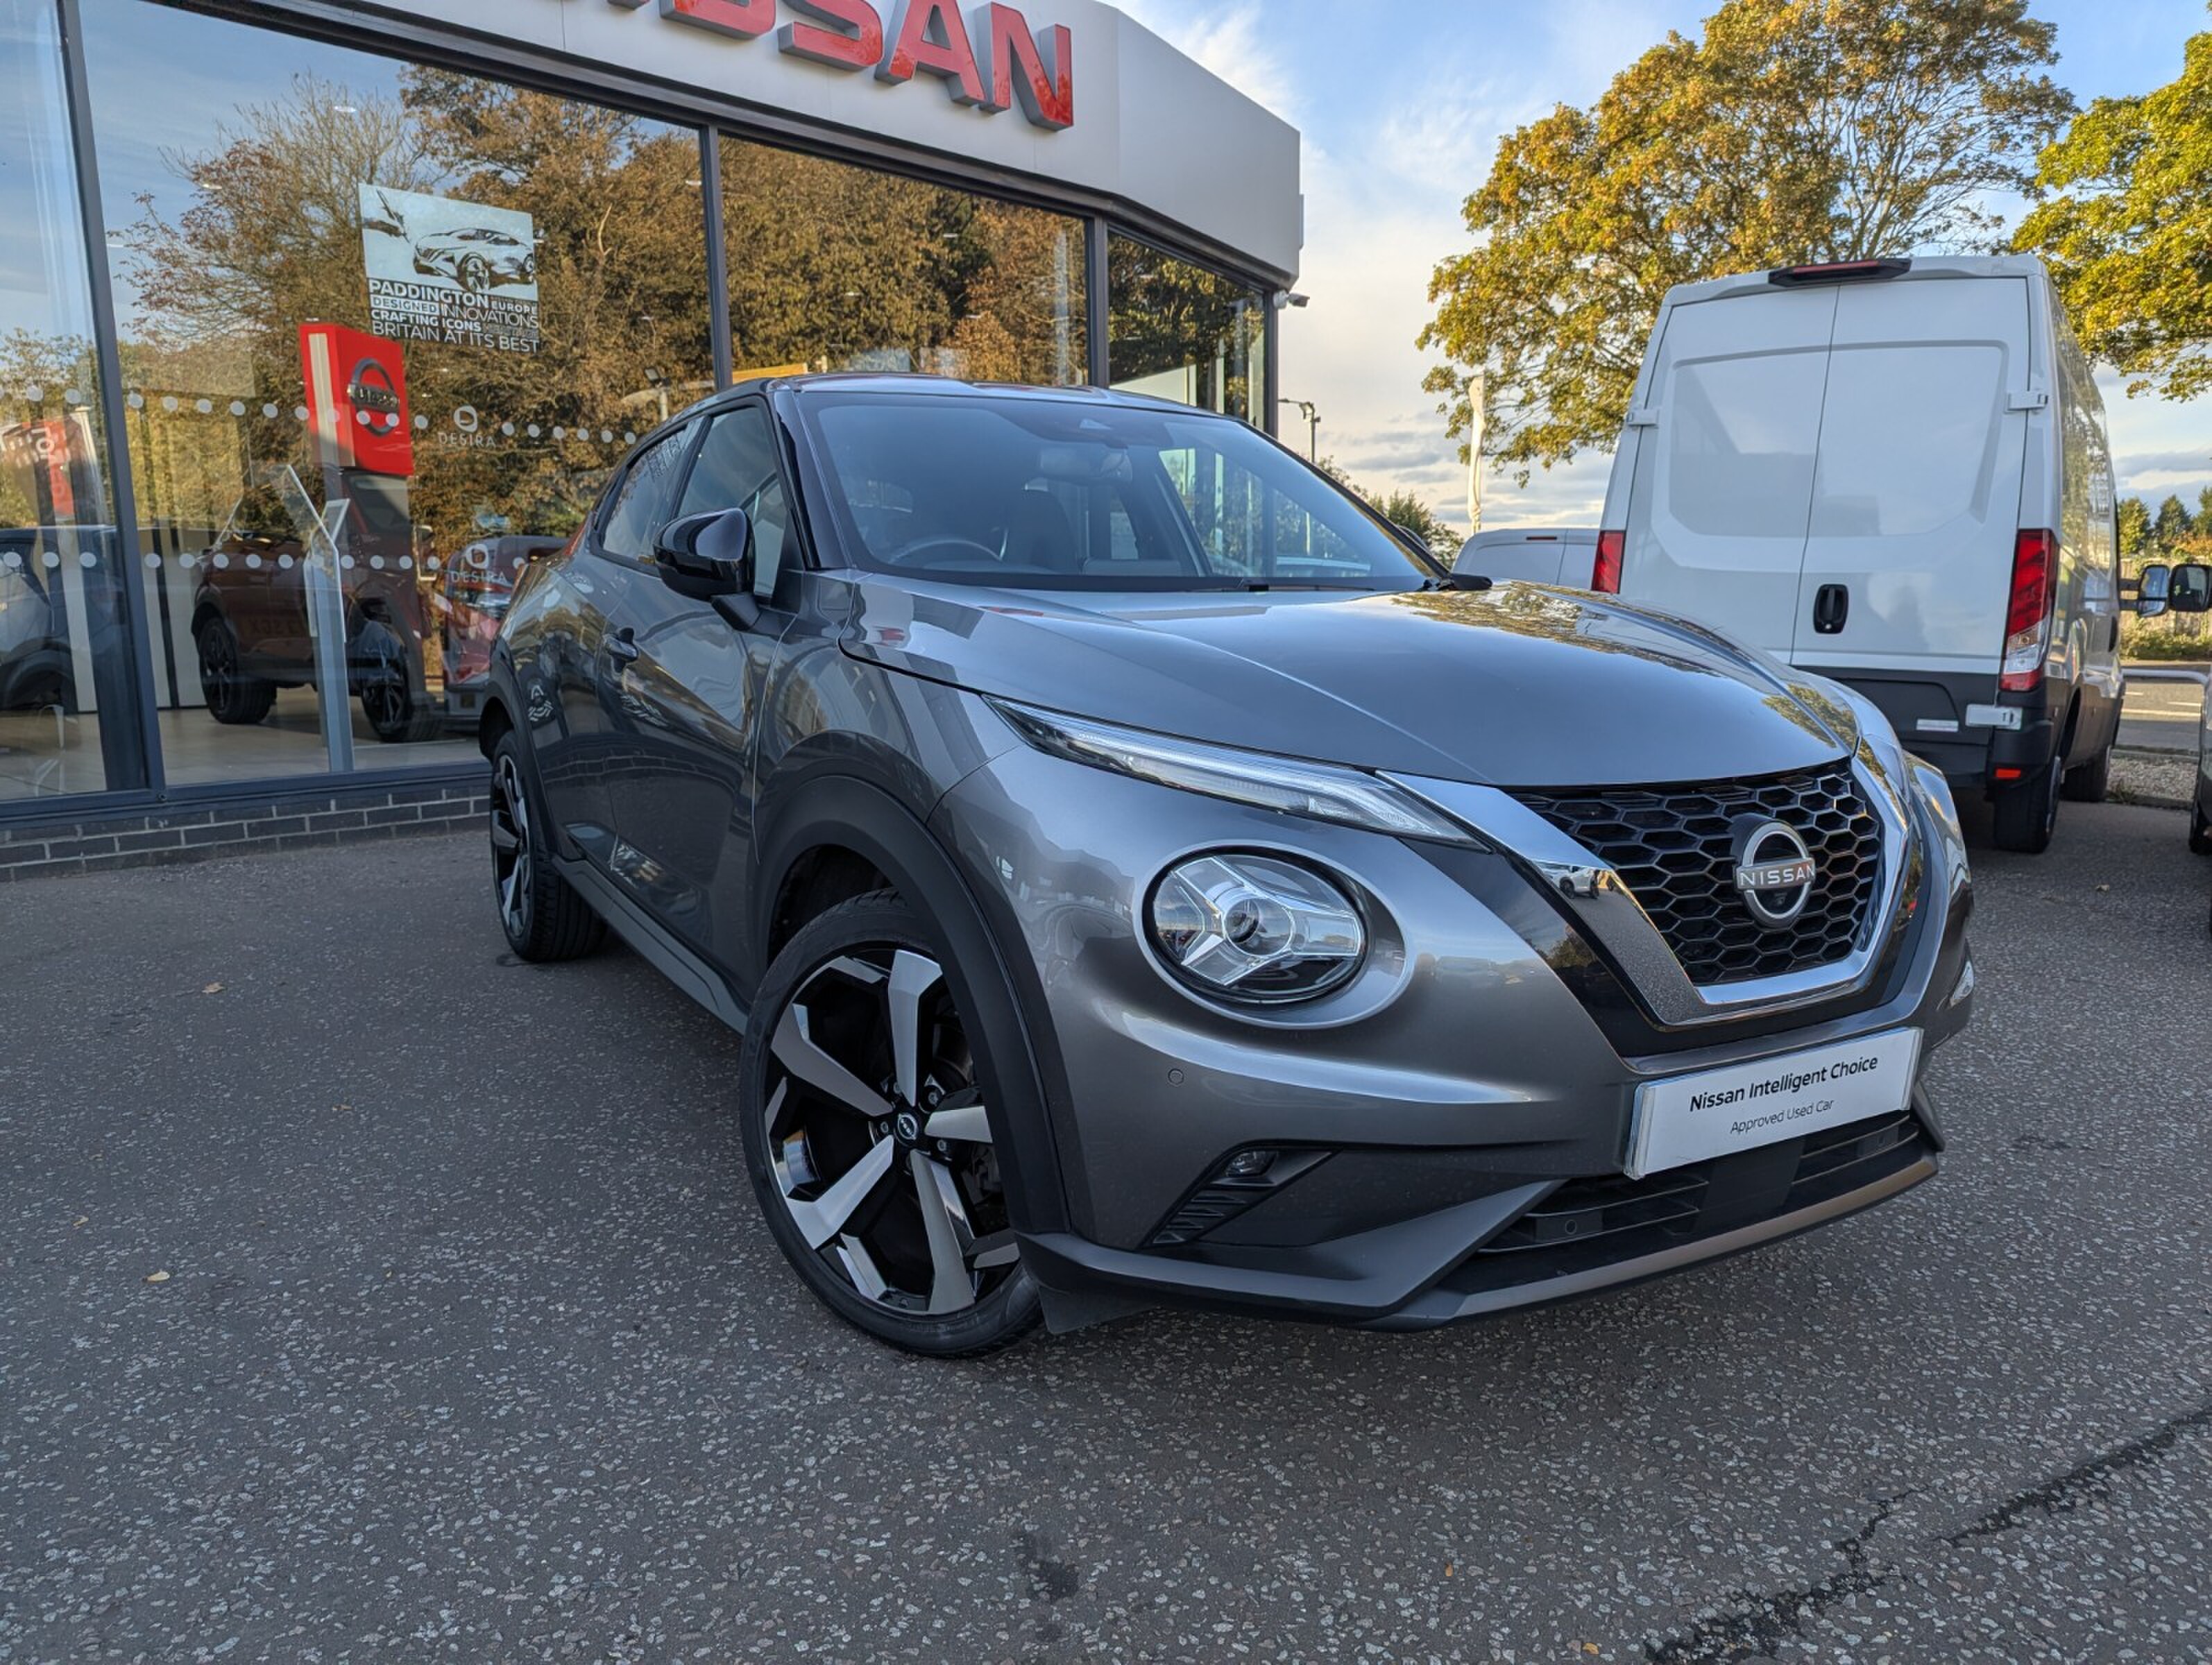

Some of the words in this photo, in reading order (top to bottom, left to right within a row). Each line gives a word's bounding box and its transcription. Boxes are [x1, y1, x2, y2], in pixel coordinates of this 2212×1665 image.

[368, 279, 489, 308] PADDINGTON
[371, 309, 439, 327] CRAFTING
[442, 317, 482, 332] ICONS
[372, 296, 437, 314] DESIGNED
[441, 303, 539, 329] INNOVATIONS
[373, 321, 440, 342] BRITAIN
[444, 330, 466, 345] AT
[469, 333, 494, 348] ITS
[499, 336, 540, 354] BEST
[437, 432, 497, 447] DESIRA
[1739, 865, 1815, 887] NISSAN
[1689, 1087, 1745, 1111] Nissan
[1749, 1068, 1828, 1100] Intelligent
[1830, 1057, 1878, 1079] Choice
[1730, 1110, 1785, 1135] Approved
[1787, 1103, 1814, 1120] Used
[1816, 1099, 1835, 1113] Car
